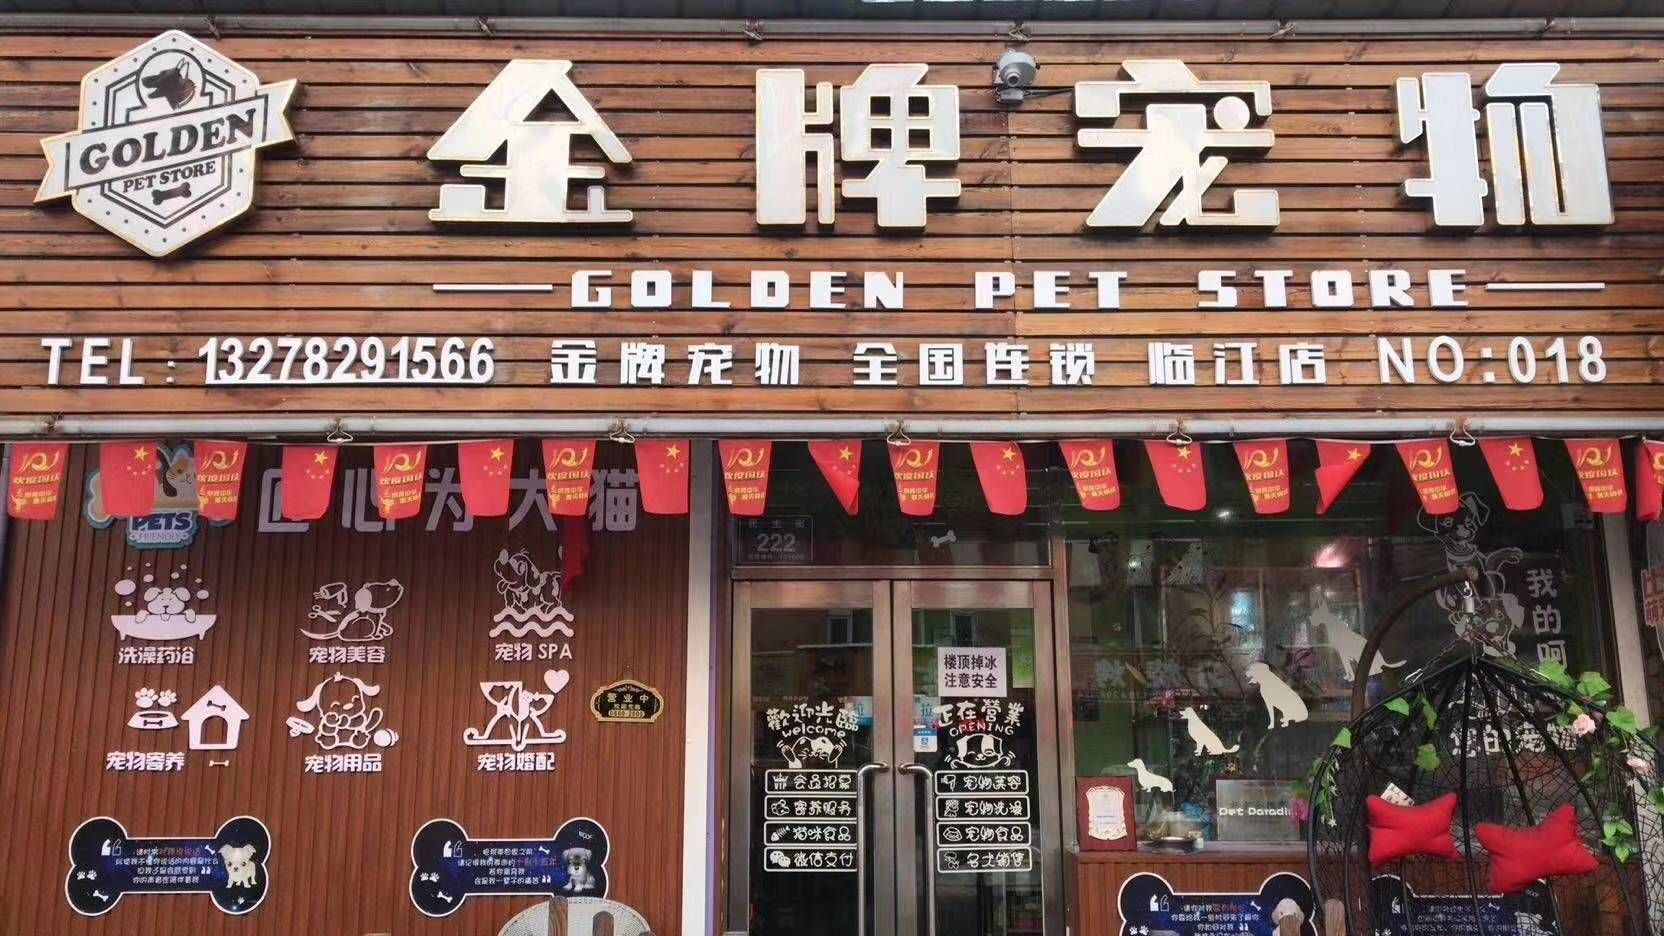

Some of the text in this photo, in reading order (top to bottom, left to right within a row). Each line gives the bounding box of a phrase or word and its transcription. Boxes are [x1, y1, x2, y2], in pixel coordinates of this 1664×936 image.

[80, 108, 256, 175] GOLDEN
[427, 59, 1614, 227] 金牌宠物
[123, 160, 216, 193] PET STORE
[571, 269, 1468, 309] GOLDEN PET STORE
[198, 336, 496, 386] 13278291566
[550, 339, 800, 386] 金牌宠物
[853, 342, 1095, 386] 全国连锁
[1147, 341, 1327, 386] 临江店
[132, 512, 191, 531] PETS
[756, 532, 796, 553] 222
[118, 646, 194, 665] 洗澡药浴
[308, 646, 386, 664] 宠物美容
[494, 643, 573, 662] 宠物 SPA
[944, 653, 998, 670] 楼顶掉冰
[944, 672, 998, 689] 注意安全
[782, 723, 847, 740] welcome
[949, 720, 1015, 737] OPENING
[106, 751, 185, 772] 宠物寄养
[304, 753, 382, 773] 宠物用品
[477, 751, 555, 771] 宠物婚配
[963, 774, 1022, 790] 宠物美容
[792, 826, 852, 842] 猫咪食品
[965, 826, 1024, 842] 宠物食品
[793, 851, 854, 868] 微信支付
